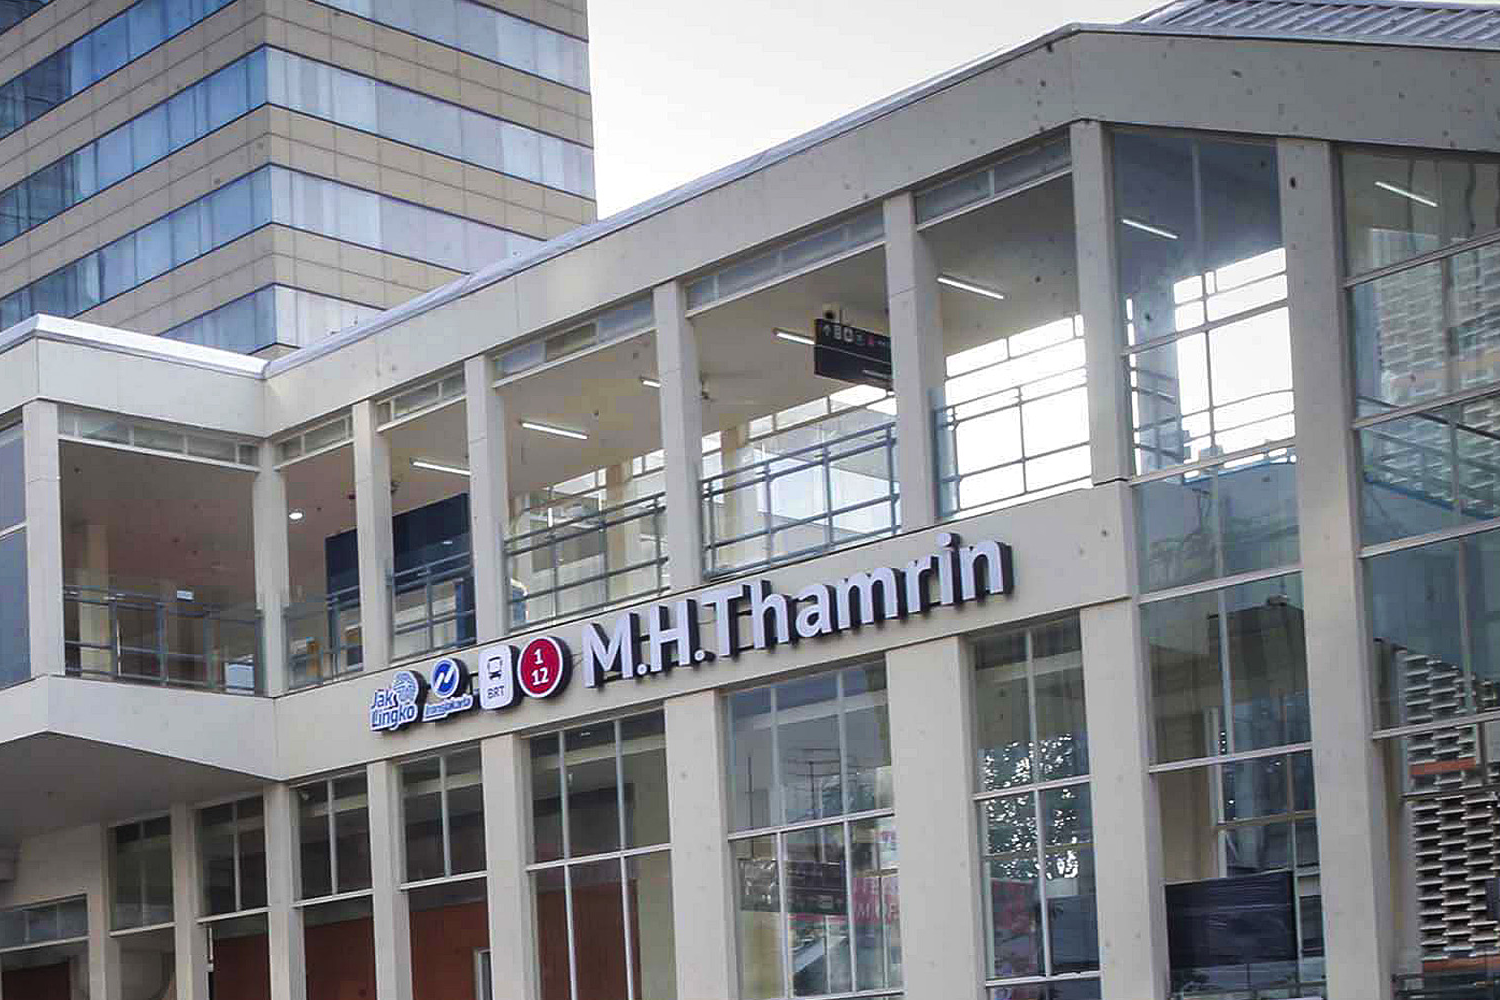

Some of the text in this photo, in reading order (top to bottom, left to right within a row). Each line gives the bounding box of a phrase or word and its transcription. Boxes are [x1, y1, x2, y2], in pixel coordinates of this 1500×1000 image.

[533, 647, 544, 666] 1
[530, 667, 550, 686] 12
[486, 685, 506, 700] BRT
